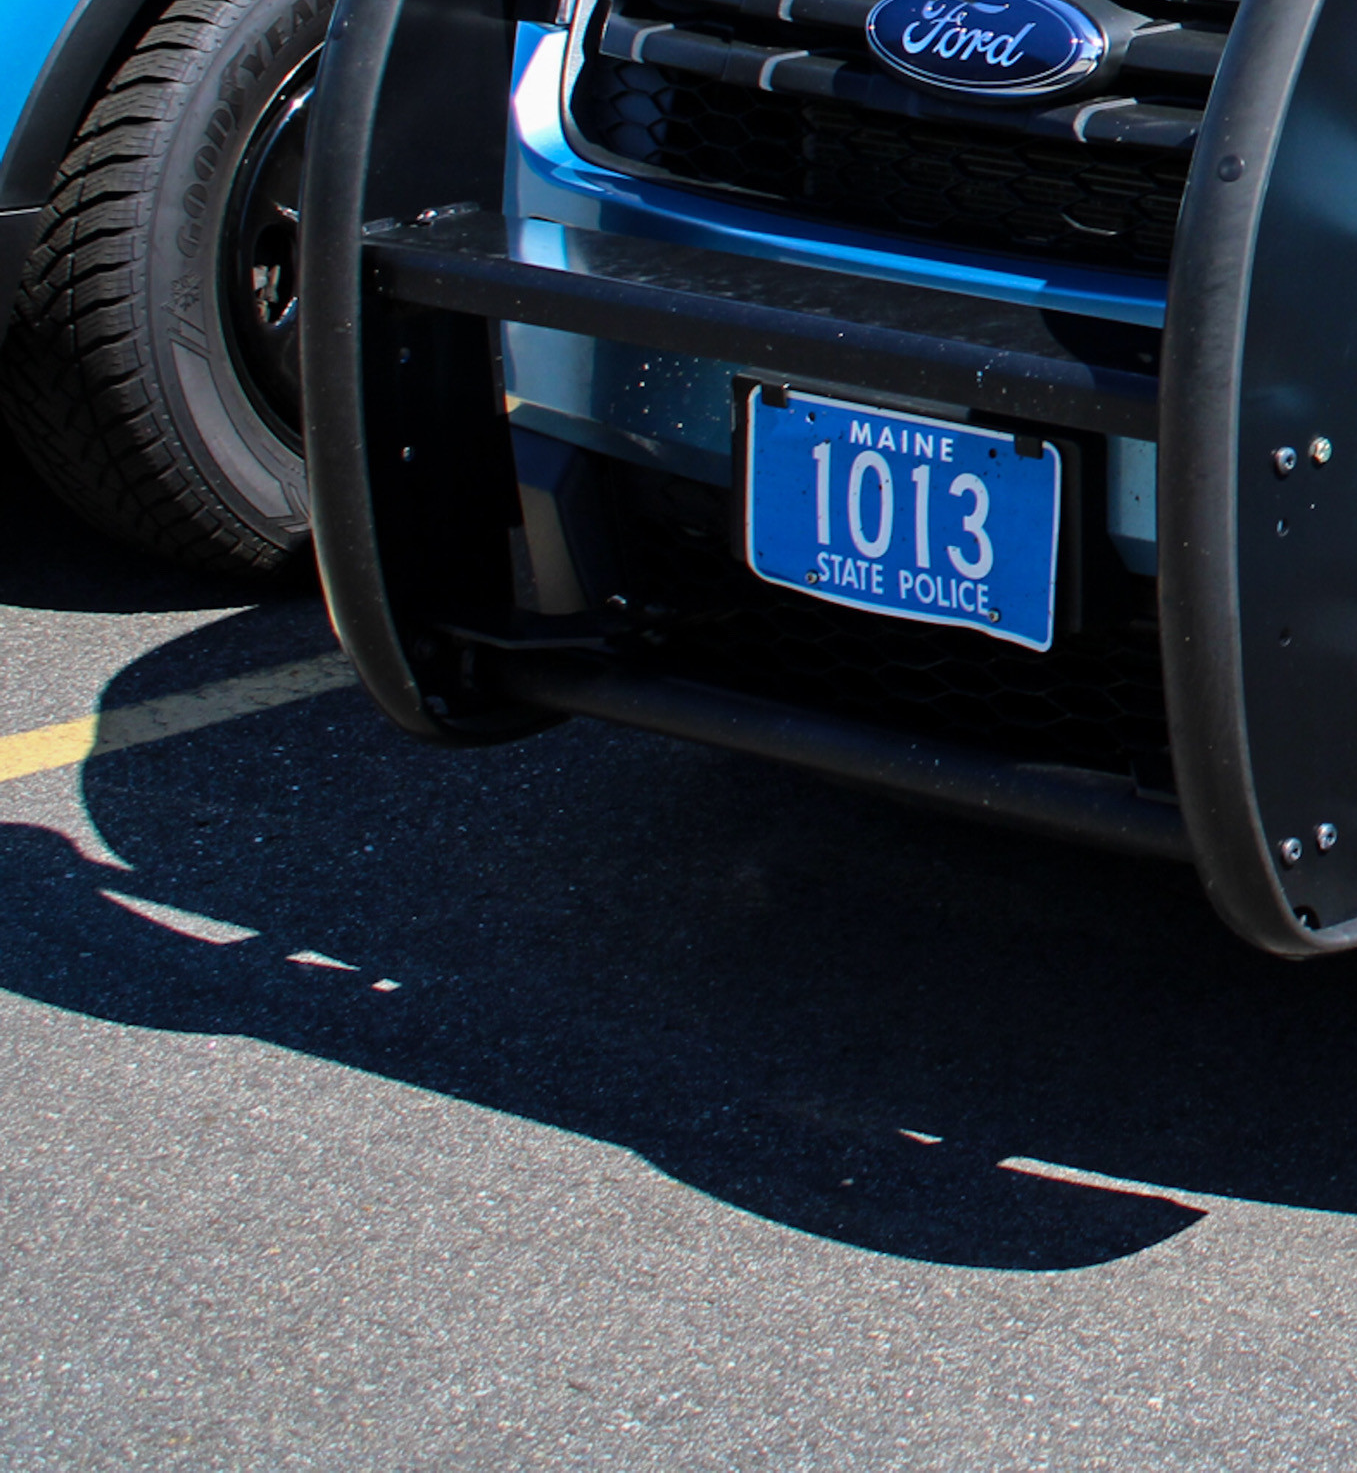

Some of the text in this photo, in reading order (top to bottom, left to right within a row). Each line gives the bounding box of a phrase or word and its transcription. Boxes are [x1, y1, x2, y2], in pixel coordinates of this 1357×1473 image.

[849, 420, 954, 463] MAINE
[812, 441, 994, 580] 1013
[816, 550, 990, 616] STATE POLICE
